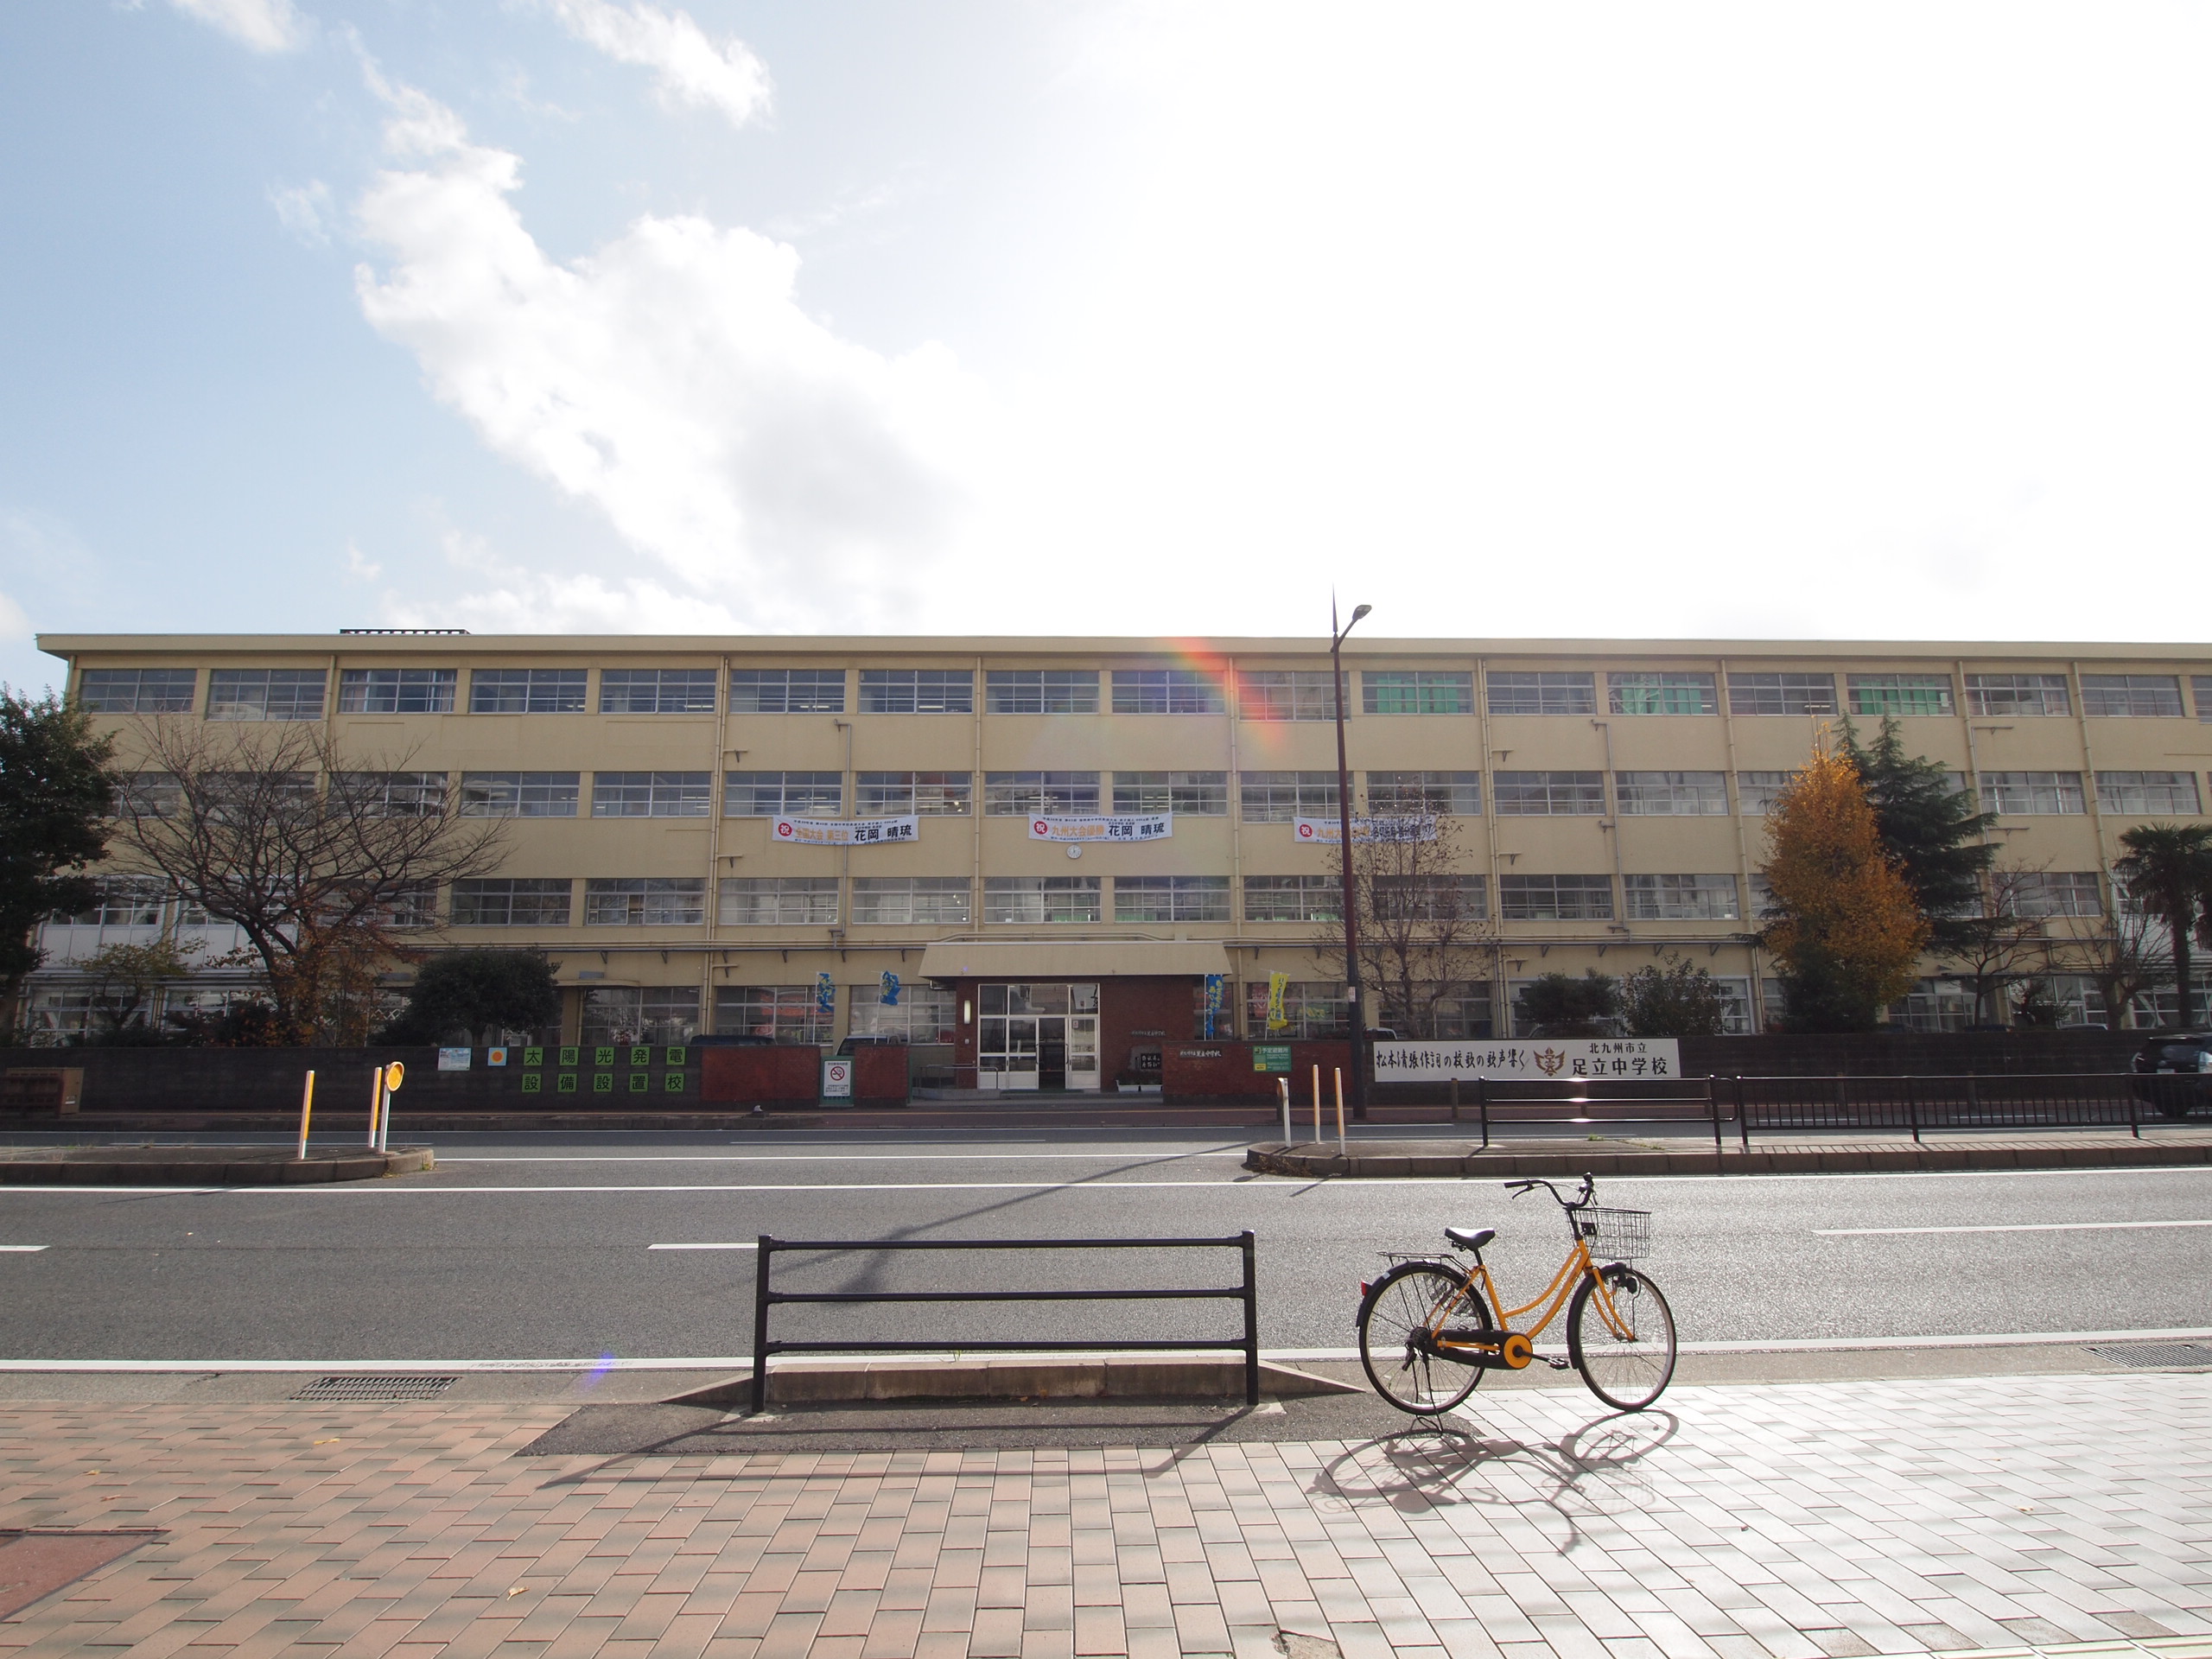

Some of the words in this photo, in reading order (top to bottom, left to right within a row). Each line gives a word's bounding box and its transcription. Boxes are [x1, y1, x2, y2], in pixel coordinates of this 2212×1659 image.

[779, 824, 791, 835] 祝
[795, 827, 823, 840] 全国大会
[827, 828, 849, 841] 第三位
[855, 829, 879, 842] 花岡
[1036, 823, 1046, 834] 祝
[1052, 825, 1104, 837] 九州大会優勝
[1109, 824, 1133, 836] 花岡
[1300, 825, 1312, 836] 祝
[1589, 1042, 1648, 1054] 北九州市立
[525, 1049, 683, 1064] 太陽光発電
[1376, 1048, 1525, 1071] 松本清張作詞の校歌の歌声響く
[1572, 1057, 1668, 1076] 足立中学校
[524, 1076, 682, 1090] 設備設置校
